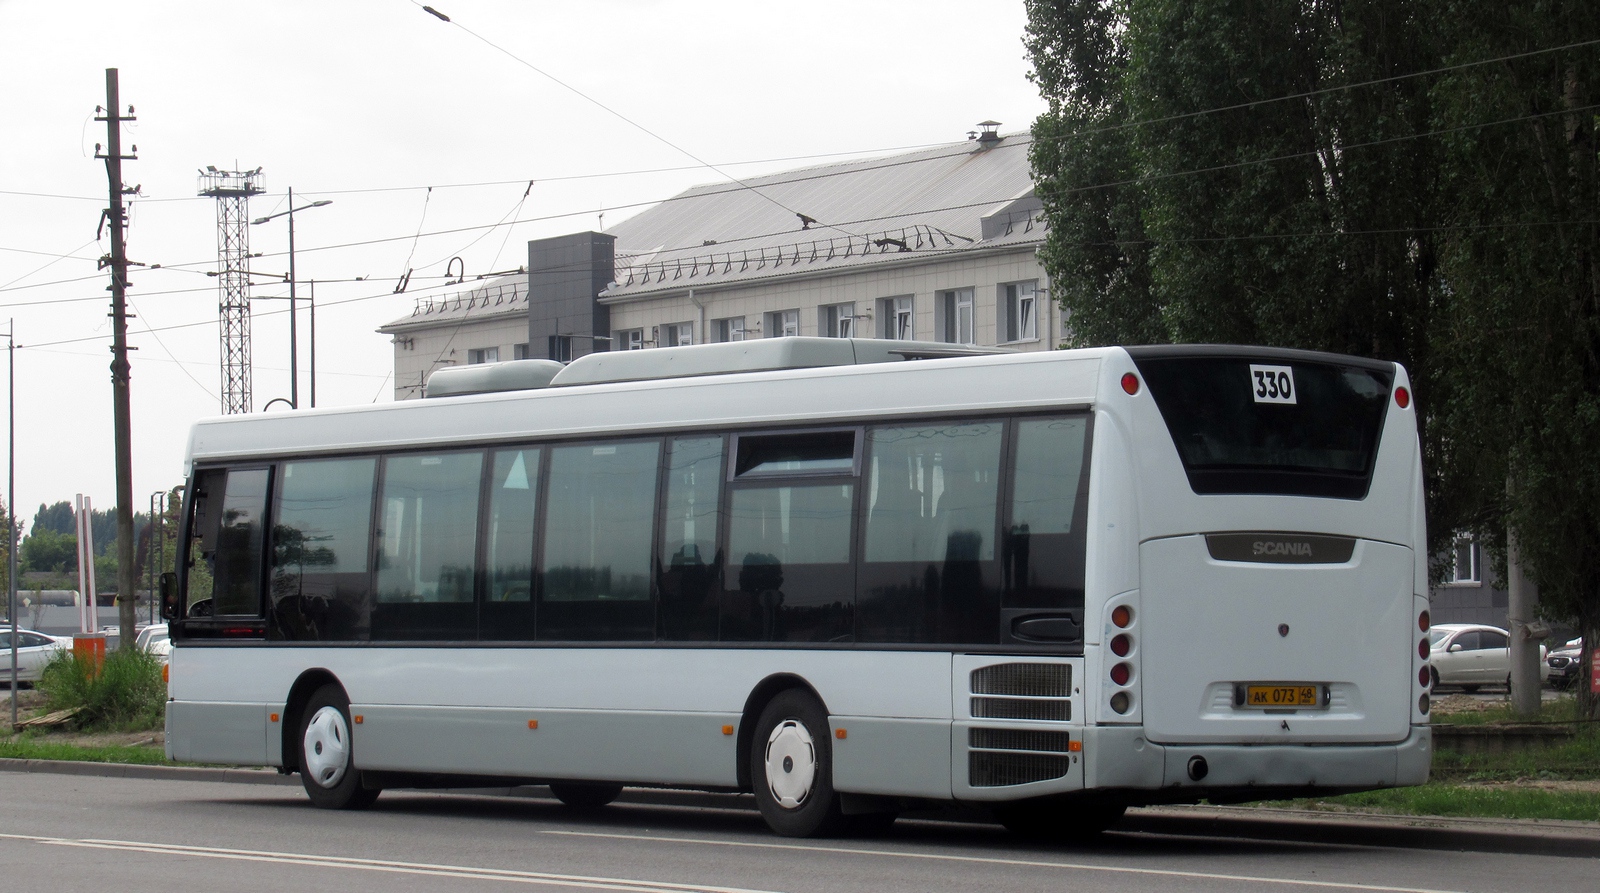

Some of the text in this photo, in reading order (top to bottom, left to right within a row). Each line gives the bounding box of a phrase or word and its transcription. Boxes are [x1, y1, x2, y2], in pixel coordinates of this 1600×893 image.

[1254, 371, 1291, 399] 330
[1253, 541, 1312, 556] SCANIA
[1273, 689, 1295, 702] 073
[1301, 688, 1312, 699] 48
